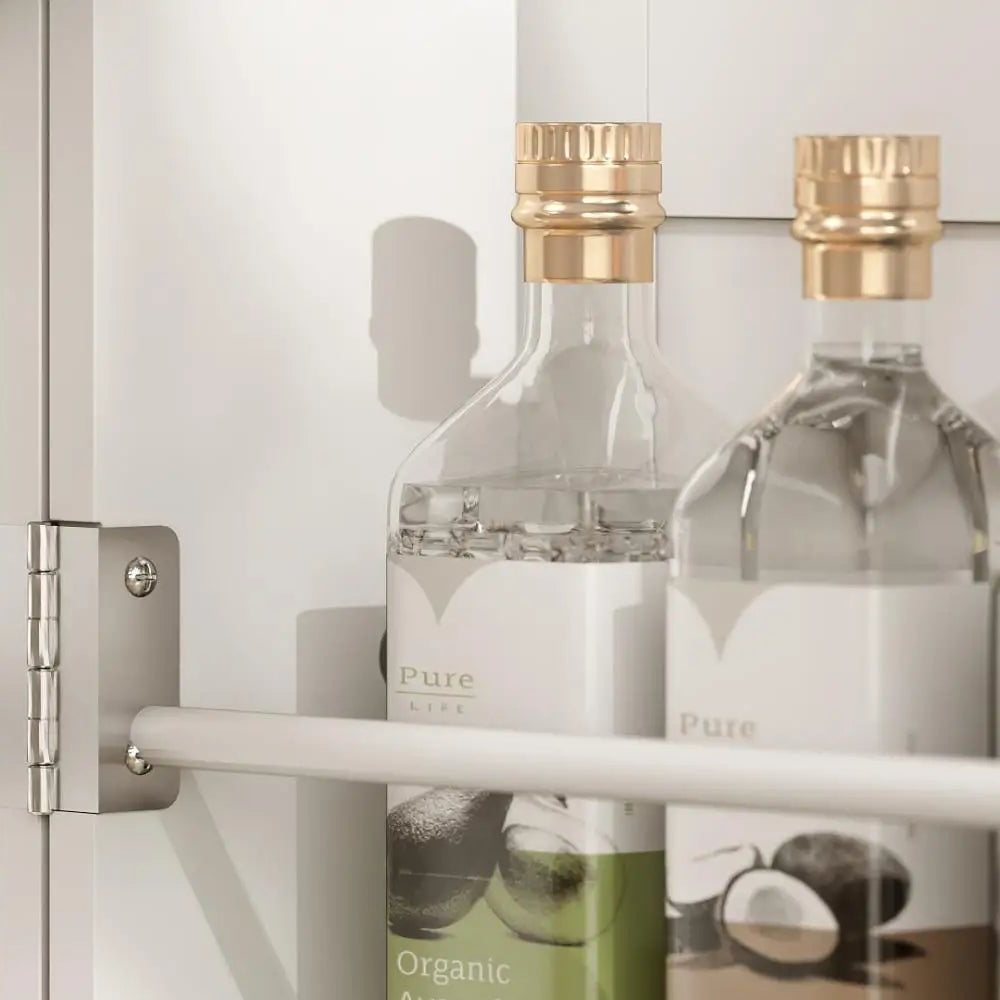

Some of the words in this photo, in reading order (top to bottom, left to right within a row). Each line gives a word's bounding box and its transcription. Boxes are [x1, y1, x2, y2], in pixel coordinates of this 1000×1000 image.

[399, 666, 475, 689] Pure
[410, 700, 465, 714] LIFE
[679, 711, 757, 738] Pure
[397, 950, 511, 986] Organic
